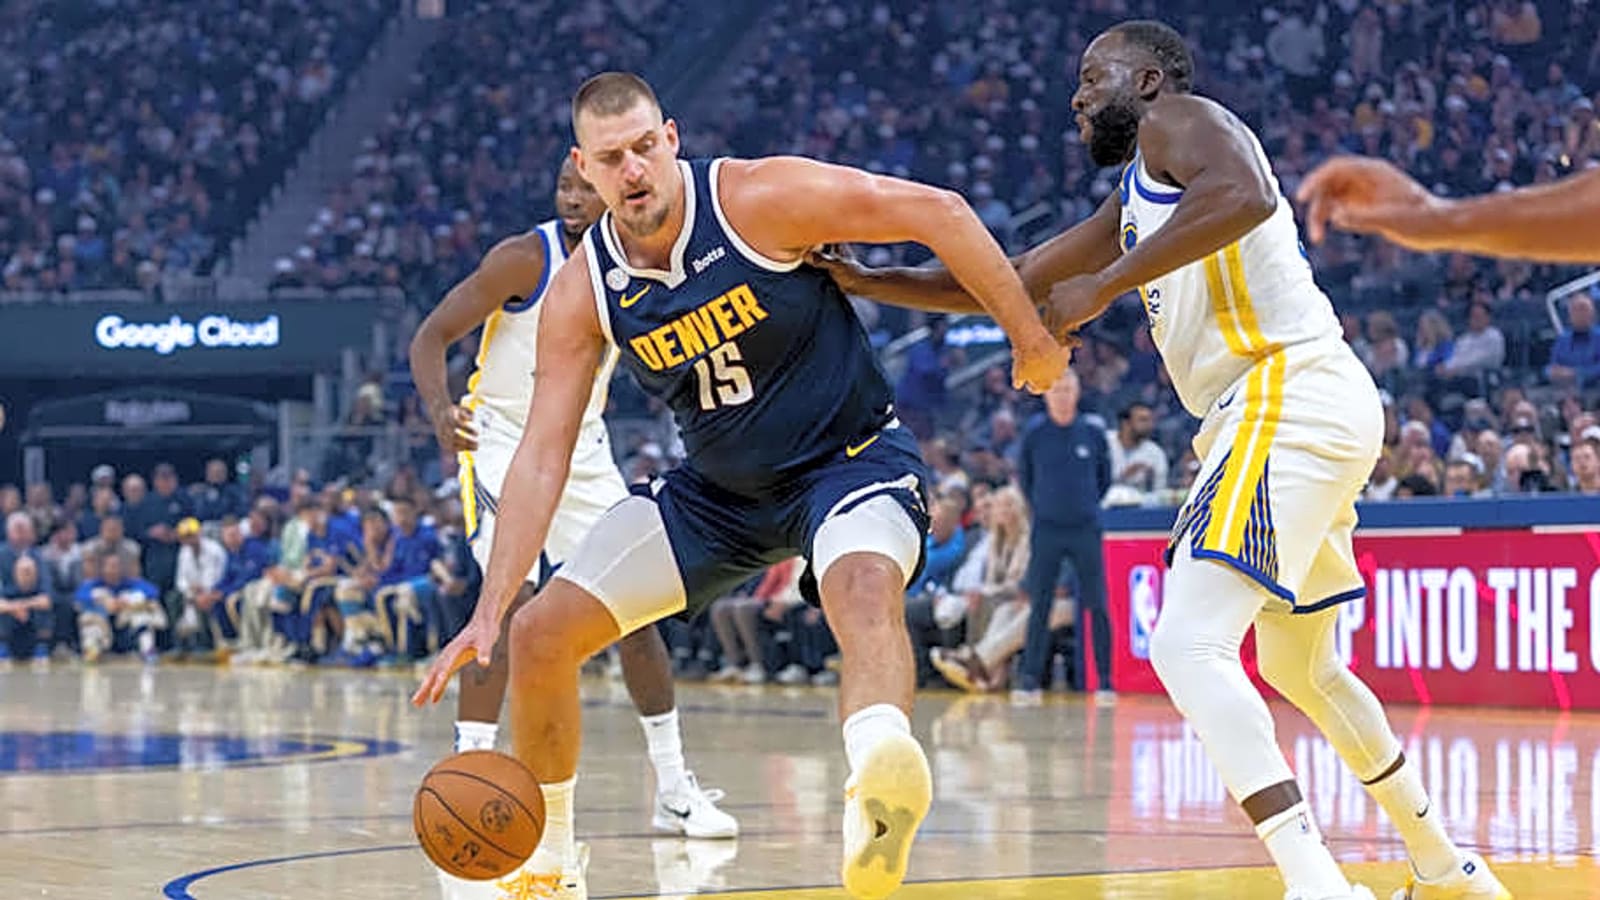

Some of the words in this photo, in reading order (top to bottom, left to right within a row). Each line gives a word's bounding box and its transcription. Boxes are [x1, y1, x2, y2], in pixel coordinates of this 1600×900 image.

[96, 315, 195, 354] Google
[197, 315, 279, 347] Cloud
[630, 283, 769, 371] DENVER
[694, 341, 754, 410] 15
[1375, 567, 1478, 671] INTO
[1487, 567, 1578, 672] THE
